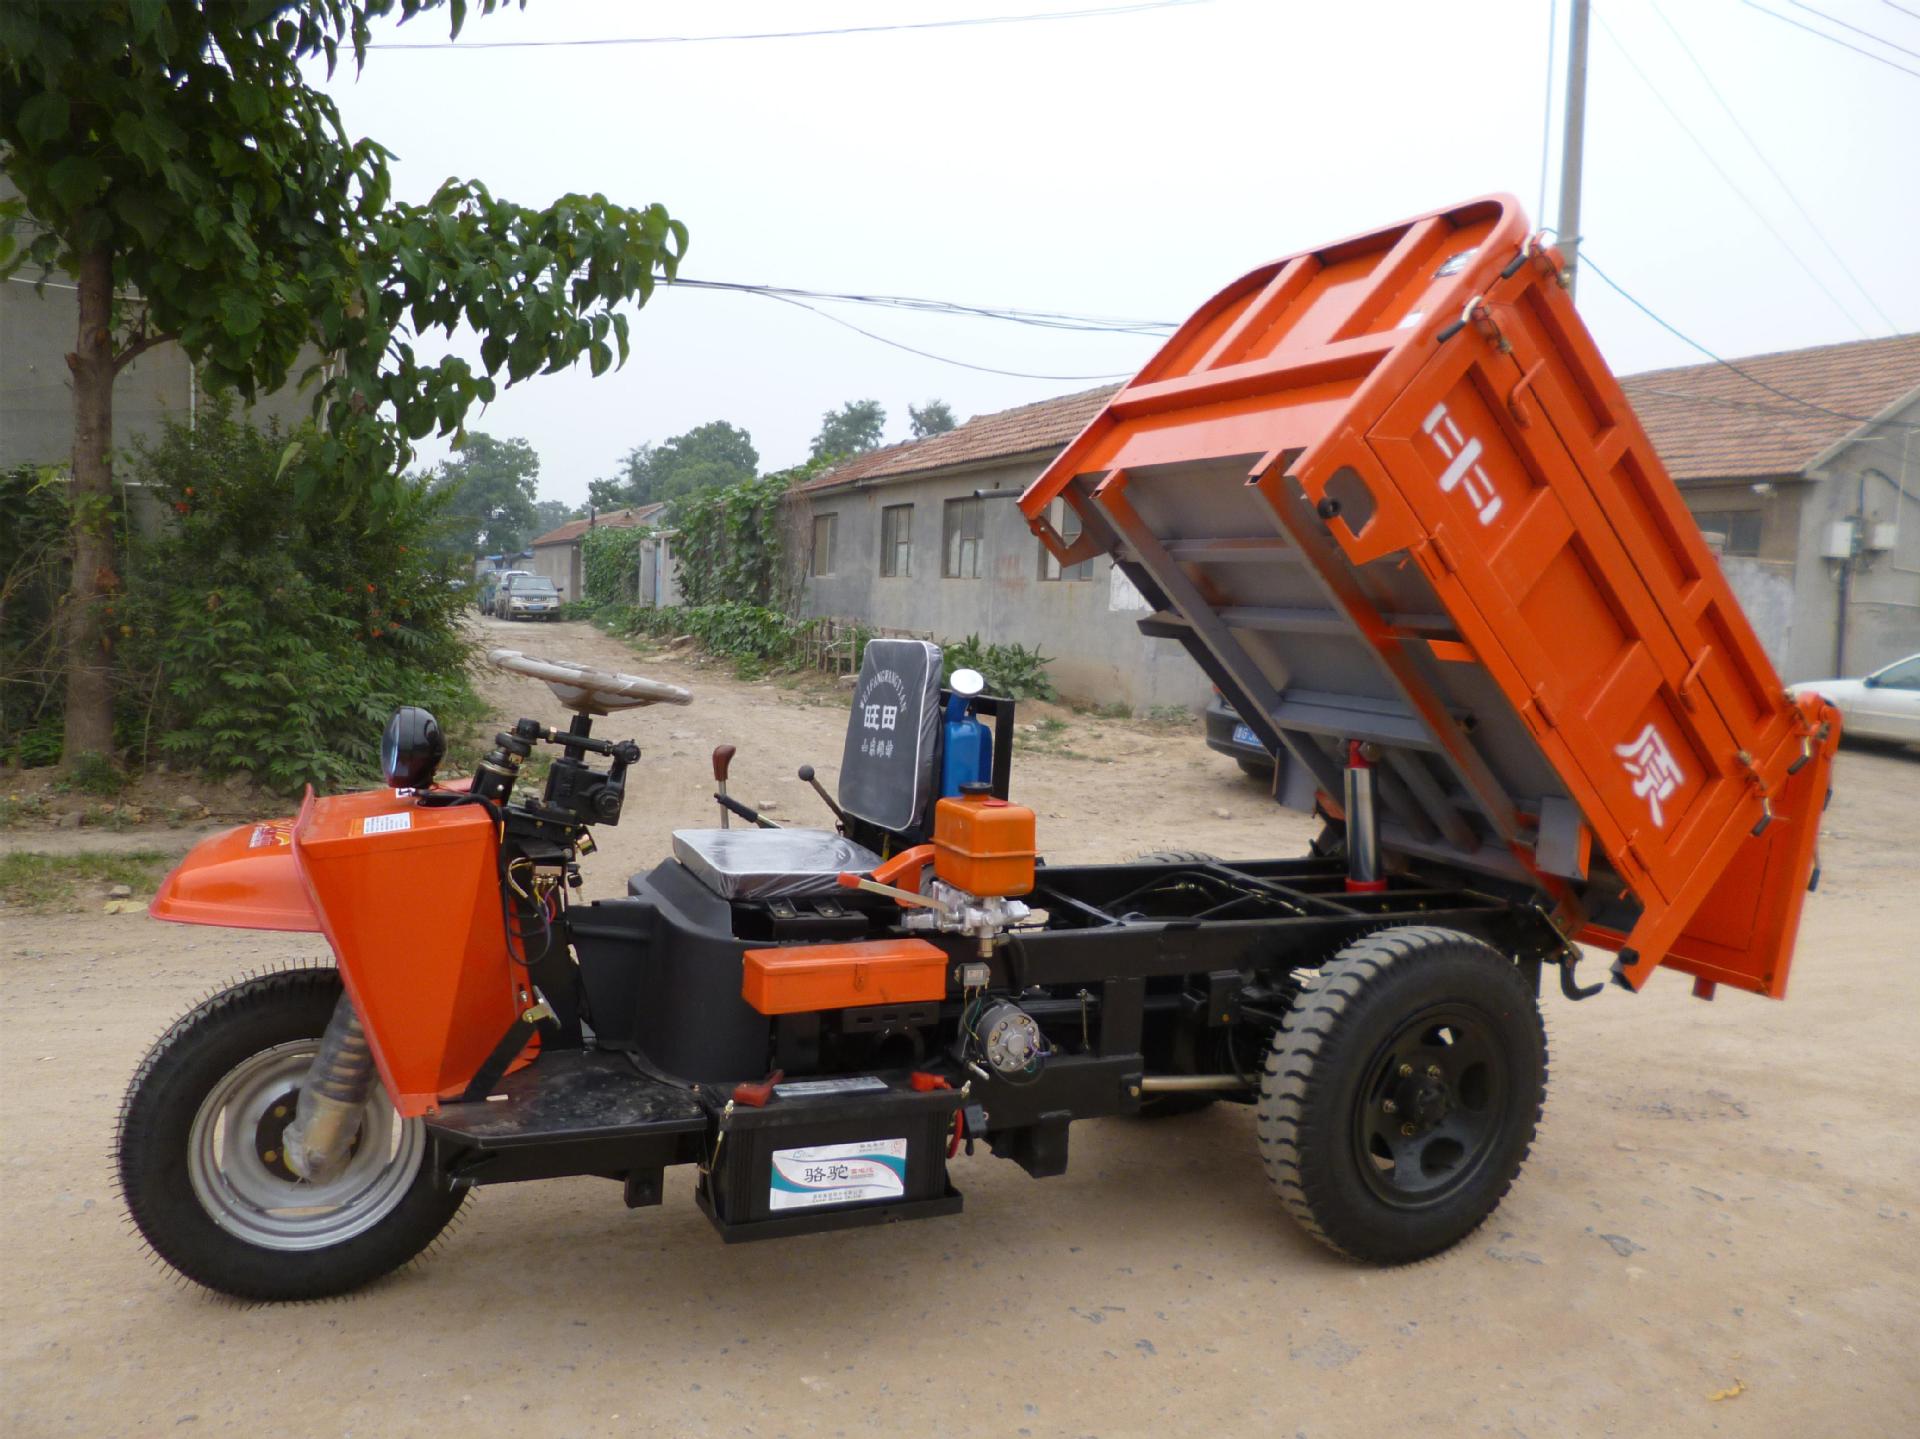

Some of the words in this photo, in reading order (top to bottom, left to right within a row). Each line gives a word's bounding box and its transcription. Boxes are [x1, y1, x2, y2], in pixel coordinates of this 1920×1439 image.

[1422, 402, 1503, 526] 中
[1615, 724, 1685, 828] 原
[863, 703, 897, 731] 旺田
[804, 1165, 848, 1183] 骆驼
